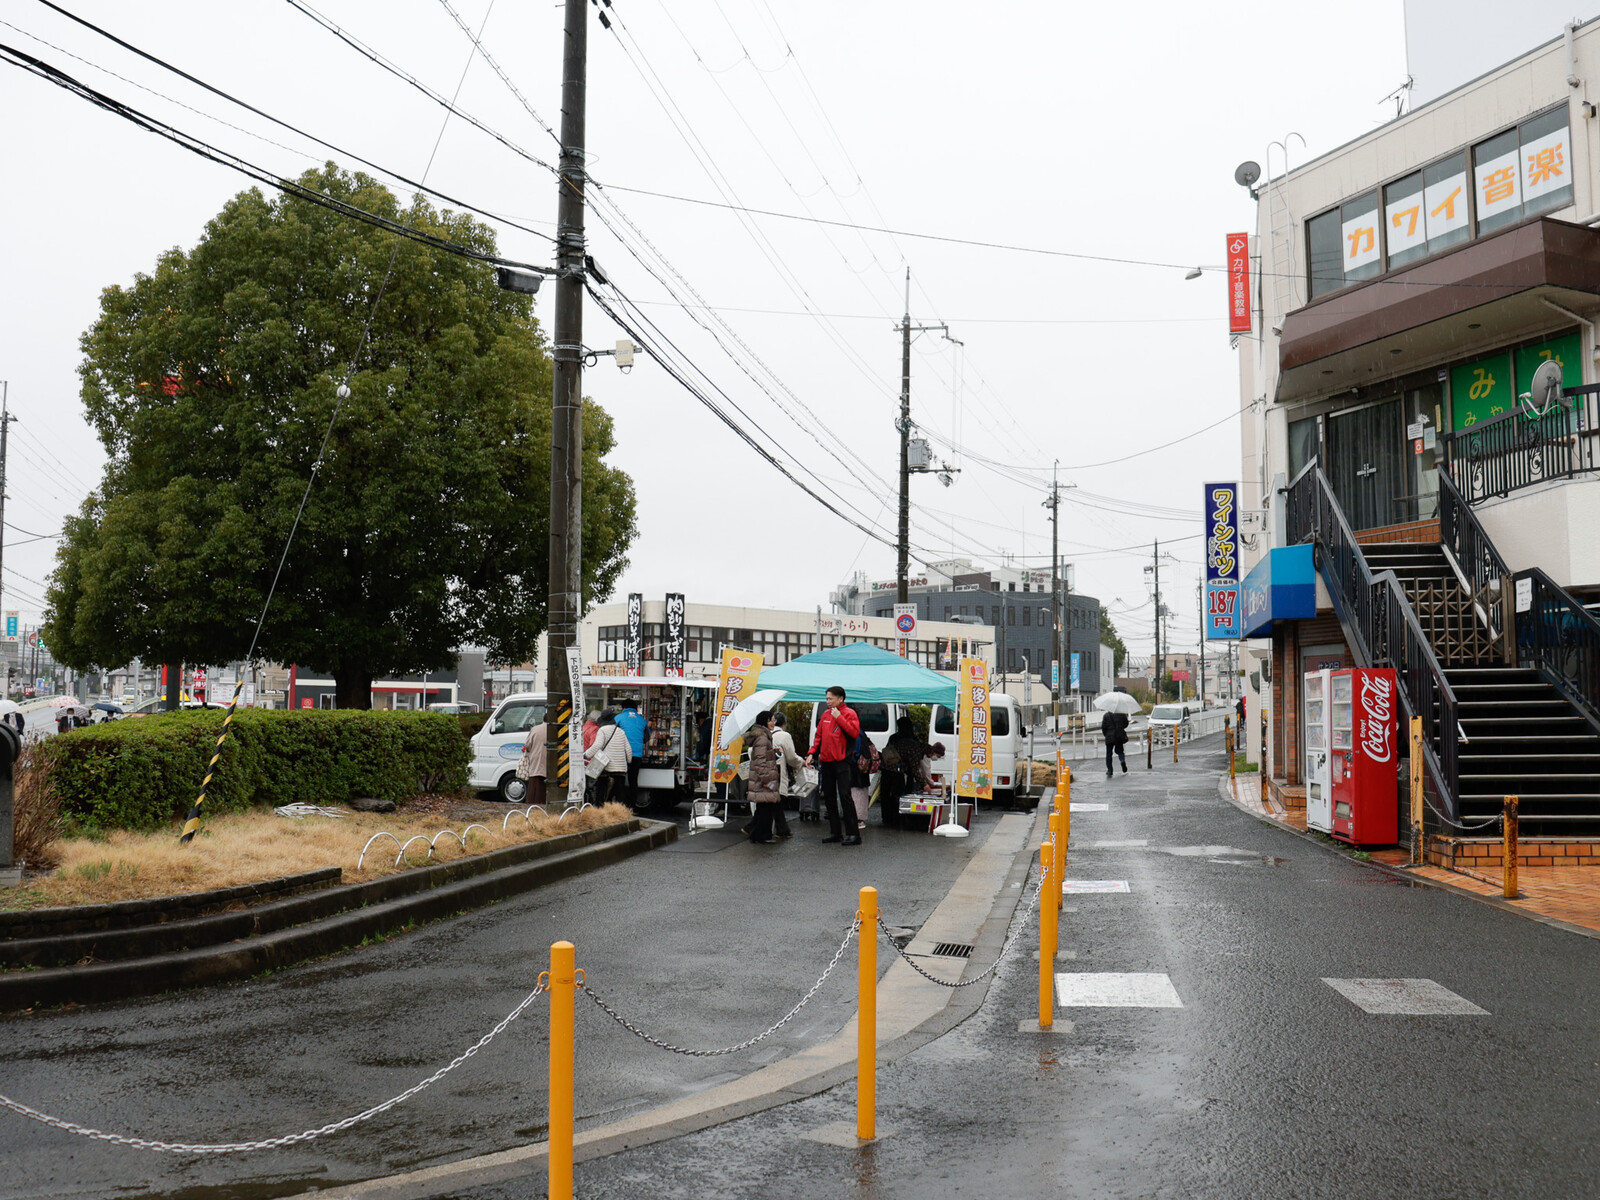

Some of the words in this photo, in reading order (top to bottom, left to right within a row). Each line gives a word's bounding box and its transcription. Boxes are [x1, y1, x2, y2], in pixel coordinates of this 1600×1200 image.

[1347, 142, 1563, 258] カワイ音楽
[1213, 489, 1234, 576] ワイシャツ
[1208, 589, 1237, 614] 187
[1213, 616, 1232, 628] 円
[970, 685, 987, 765] 移動販売
